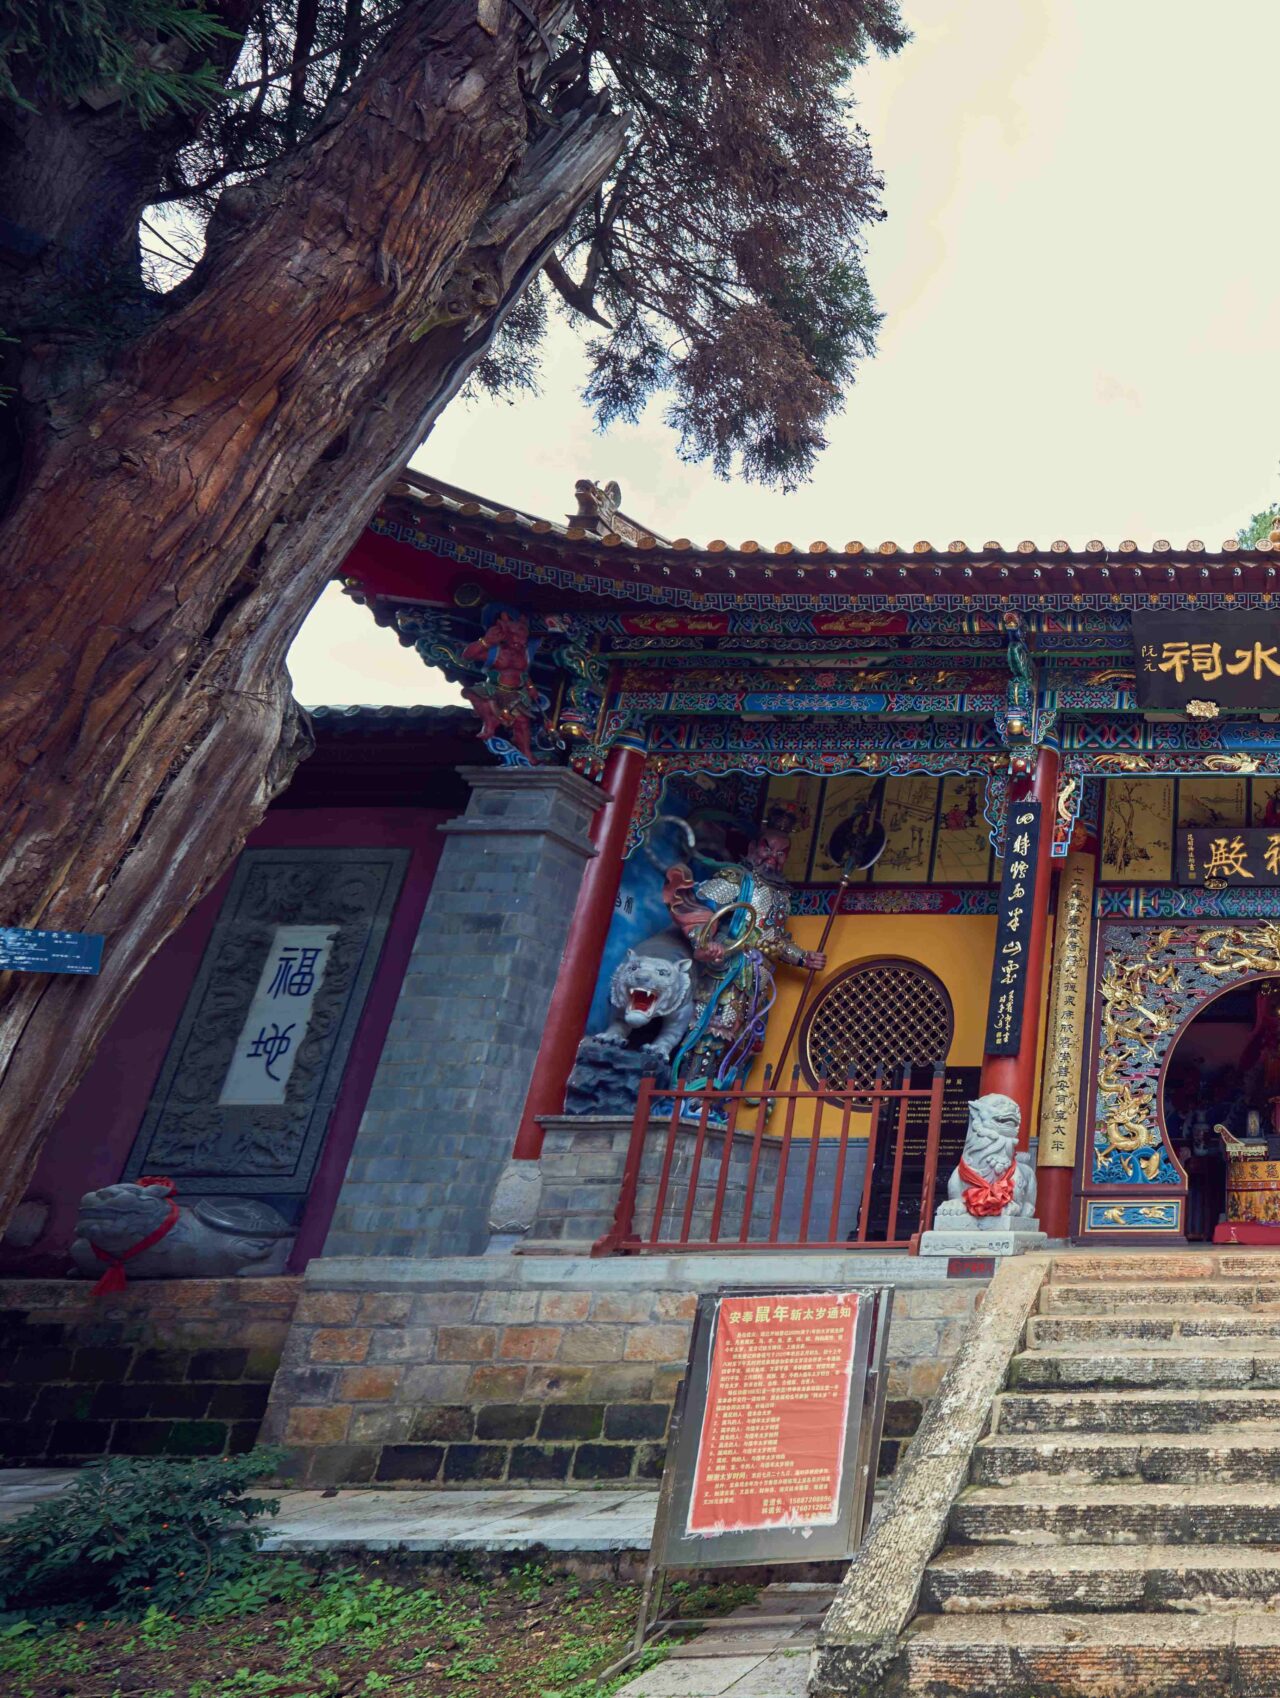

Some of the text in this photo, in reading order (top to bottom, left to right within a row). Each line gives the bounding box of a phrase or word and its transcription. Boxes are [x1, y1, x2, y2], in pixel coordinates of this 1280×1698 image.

[729, 1305, 851, 1324] 安奉鼠年新太岁通知
